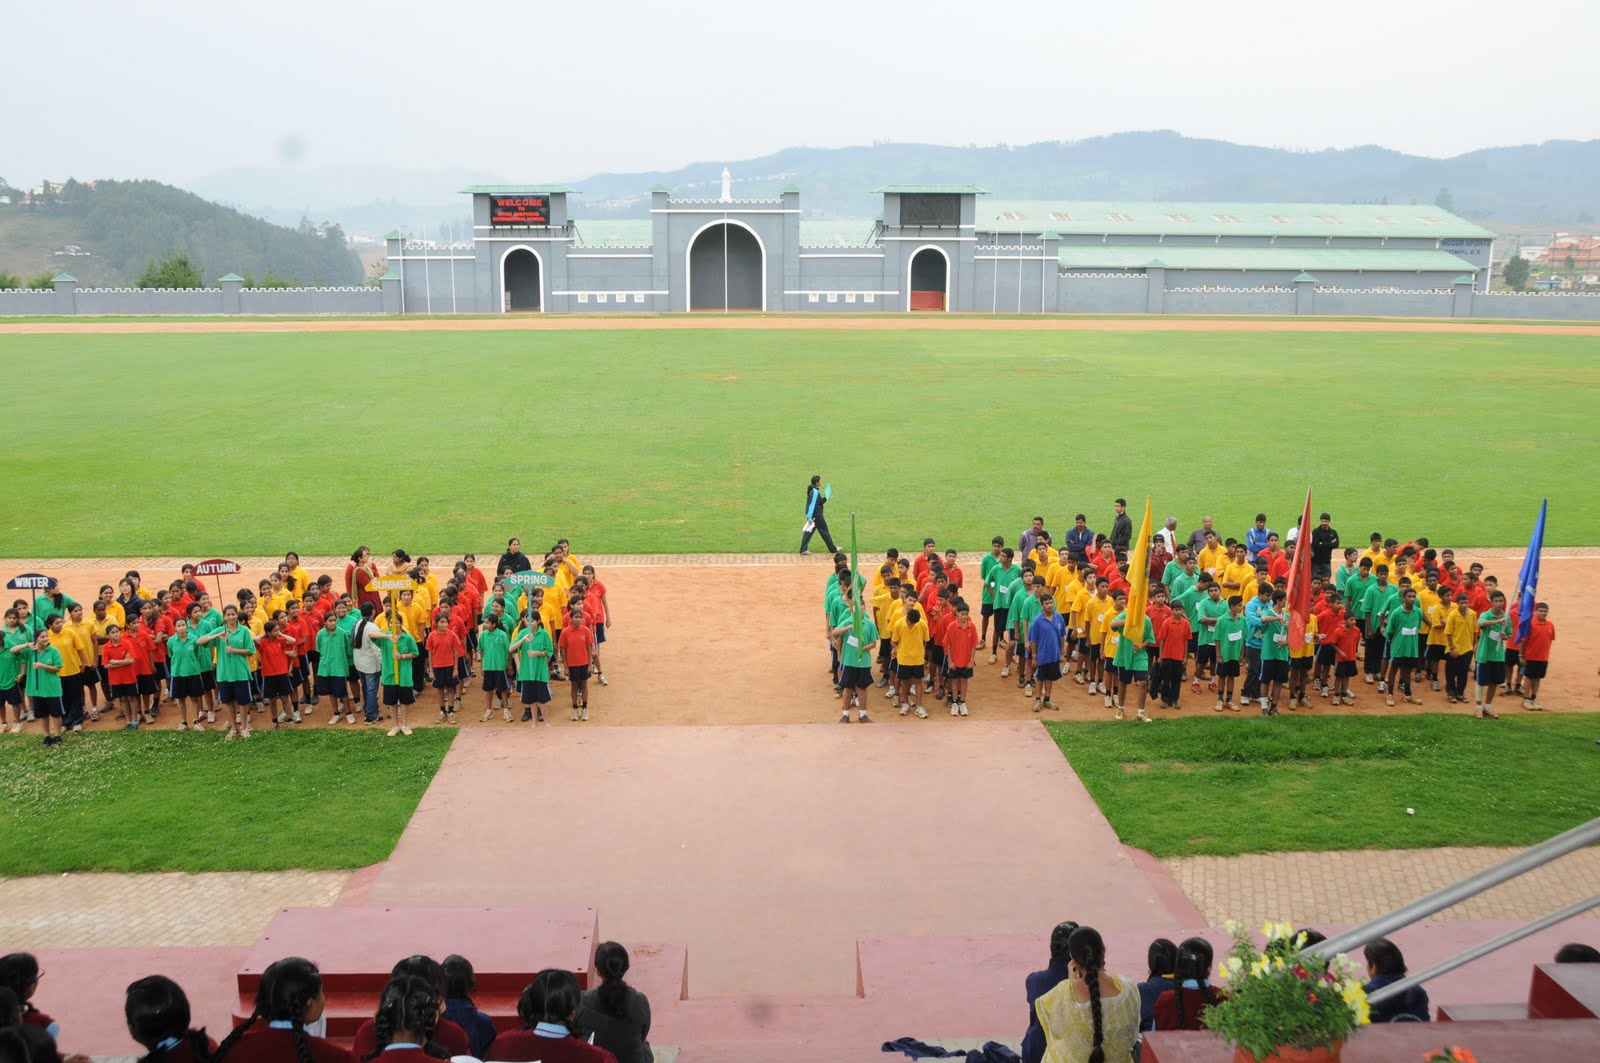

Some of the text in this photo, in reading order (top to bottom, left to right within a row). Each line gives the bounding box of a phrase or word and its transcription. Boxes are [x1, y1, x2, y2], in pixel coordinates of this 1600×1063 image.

[497, 199, 543, 207] WELCOME
[1465, 239, 1491, 247] SPORTS
[196, 562, 237, 574] AUTUMN
[14, 577, 49, 588] WINTER
[371, 579, 412, 590] SUMMER
[510, 574, 548, 585] SPRING
